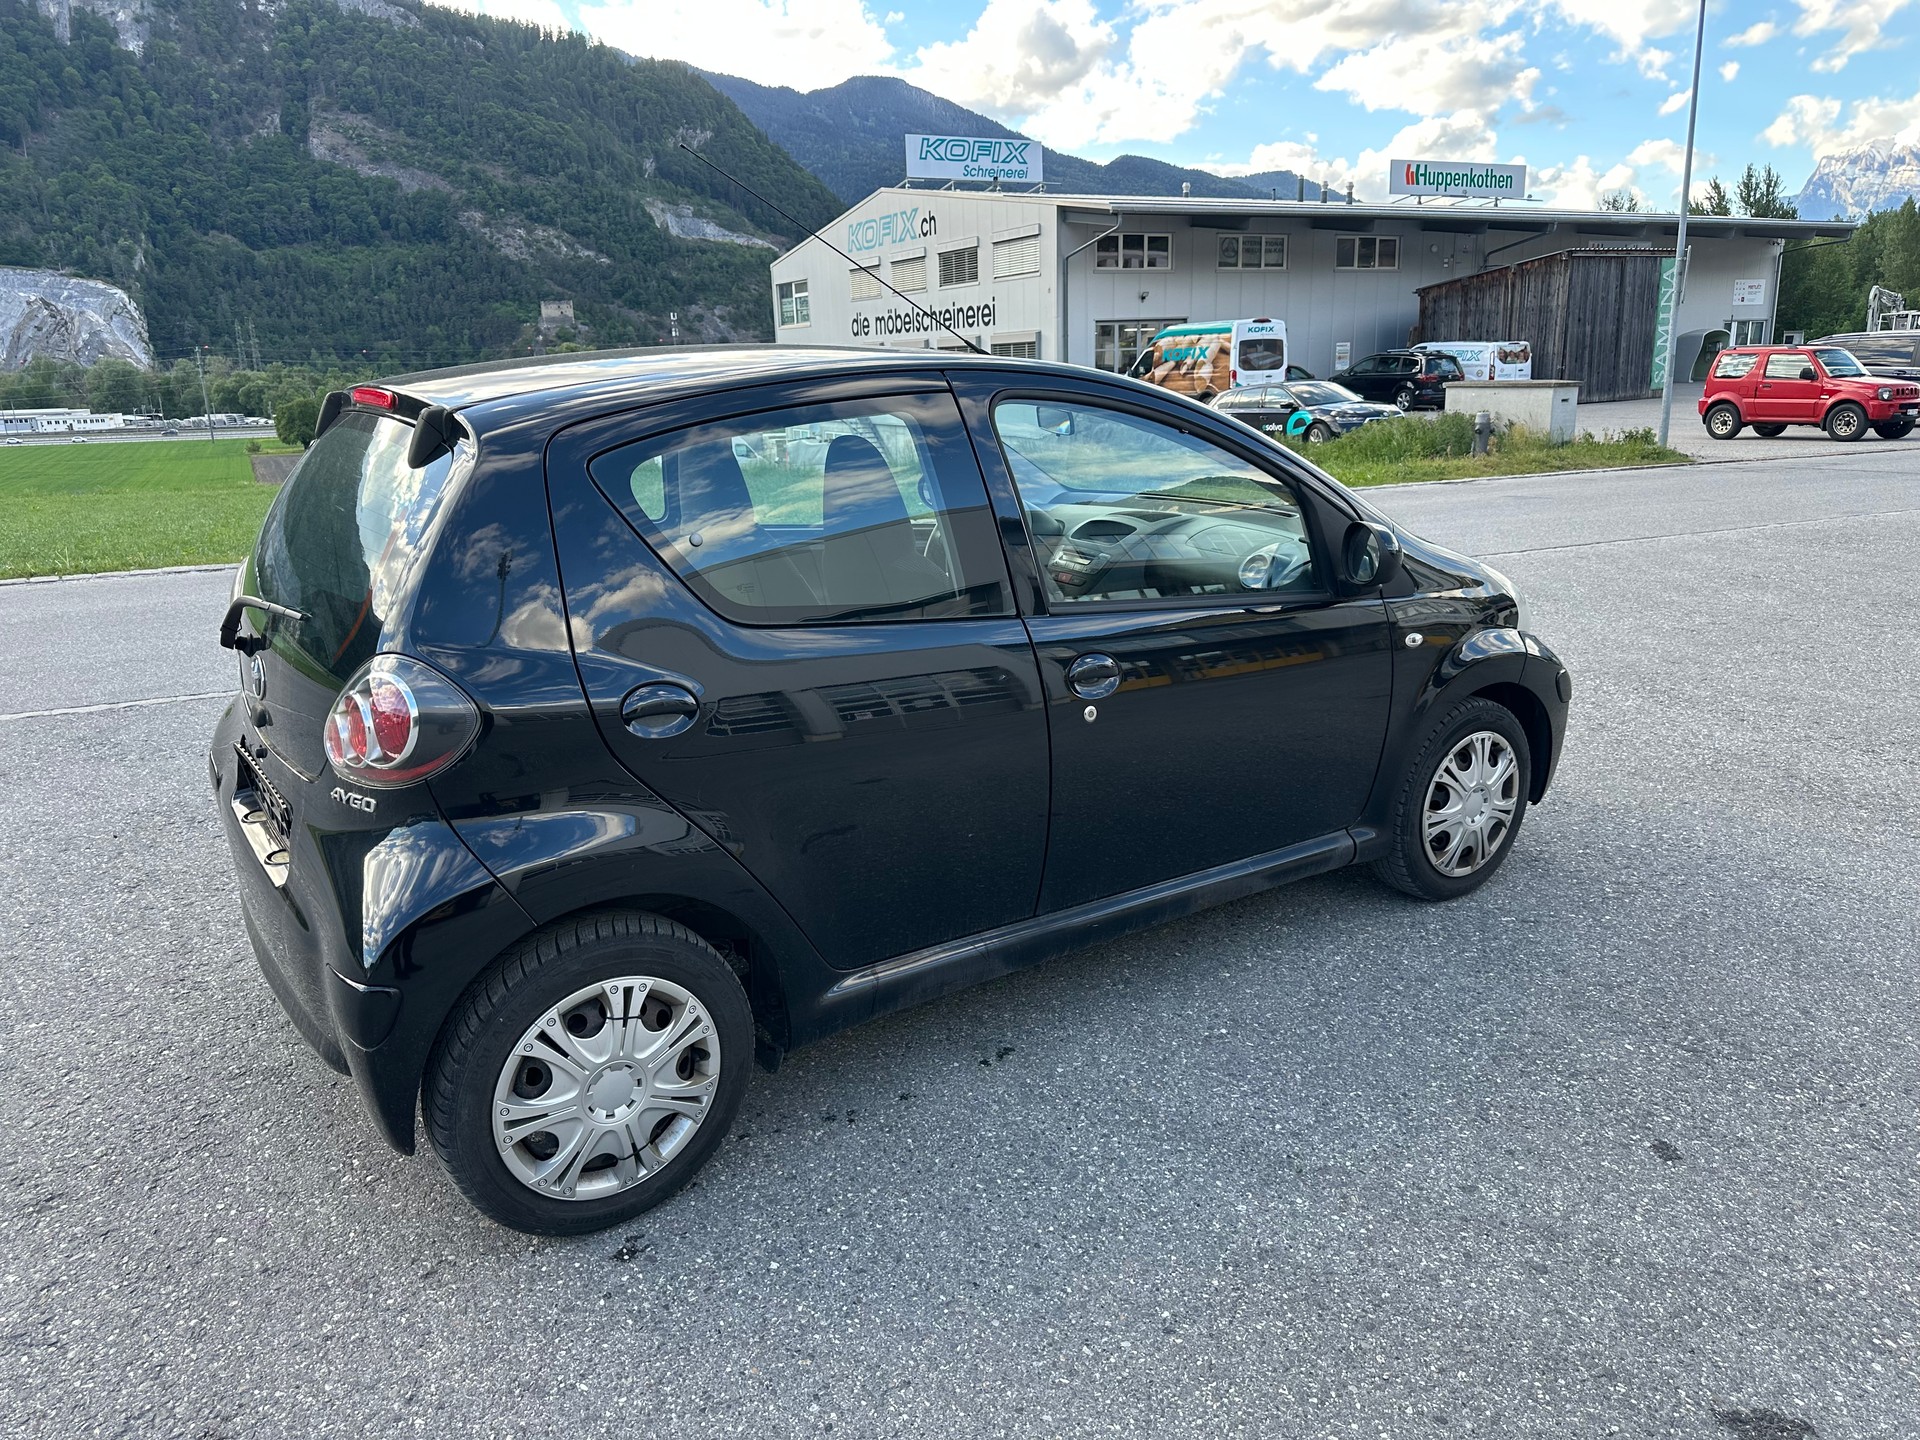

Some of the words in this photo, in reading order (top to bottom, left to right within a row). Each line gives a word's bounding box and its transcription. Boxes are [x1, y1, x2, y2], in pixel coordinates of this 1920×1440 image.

[919, 137, 1031, 165] KOFIX
[963, 164, 1029, 179] Schreinerei
[1415, 163, 1513, 192] Huppenkothen
[847, 207, 937, 253] KOFIX.ch
[851, 312, 870, 337] die
[875, 296, 996, 336] möbelschreinerei
[1247, 326, 1275, 334] KOFIX
[1654, 265, 1677, 383] SAMINA
[1162, 345, 1210, 362] KOFIX
[1262, 422, 1283, 432] esolva
[330, 787, 378, 813] AYGO
